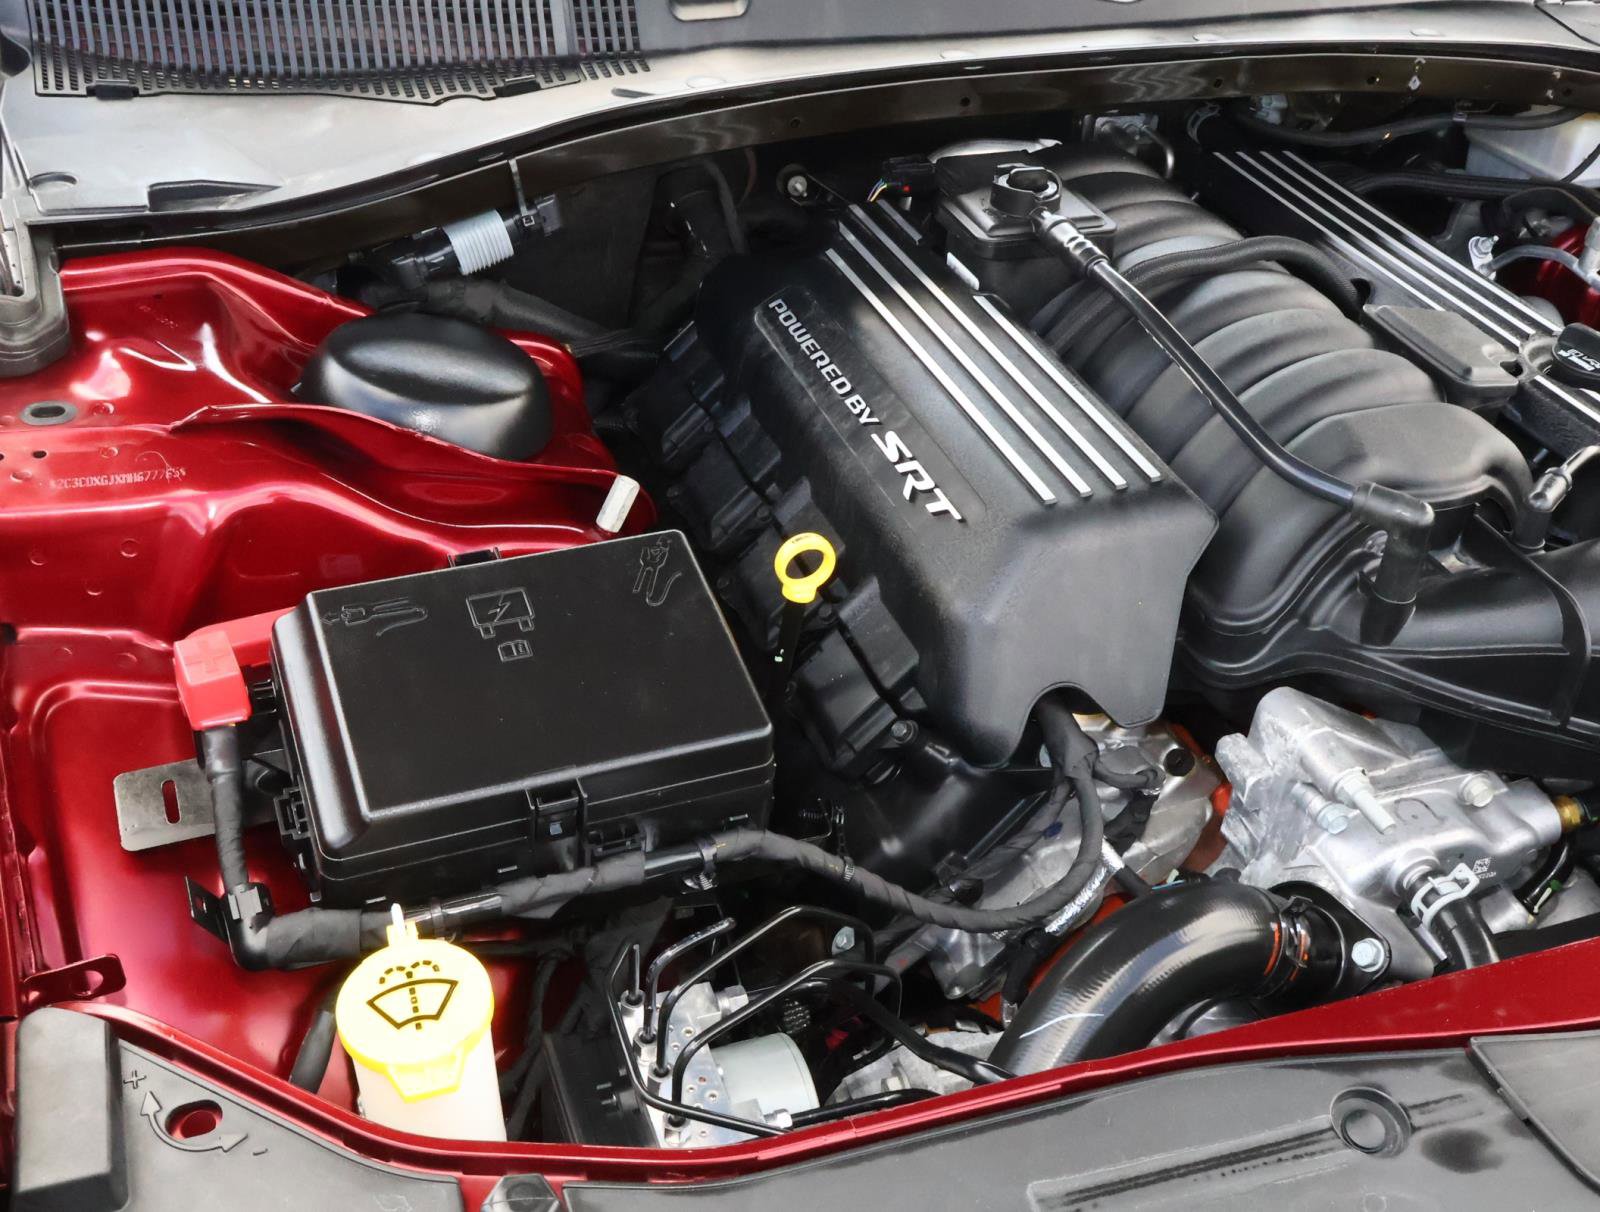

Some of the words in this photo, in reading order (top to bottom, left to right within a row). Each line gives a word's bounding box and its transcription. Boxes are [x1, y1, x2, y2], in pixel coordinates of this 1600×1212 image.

[768, 299, 852, 395] POWERED
[845, 395, 880, 425] BY
[870, 430, 963, 520] SRT
